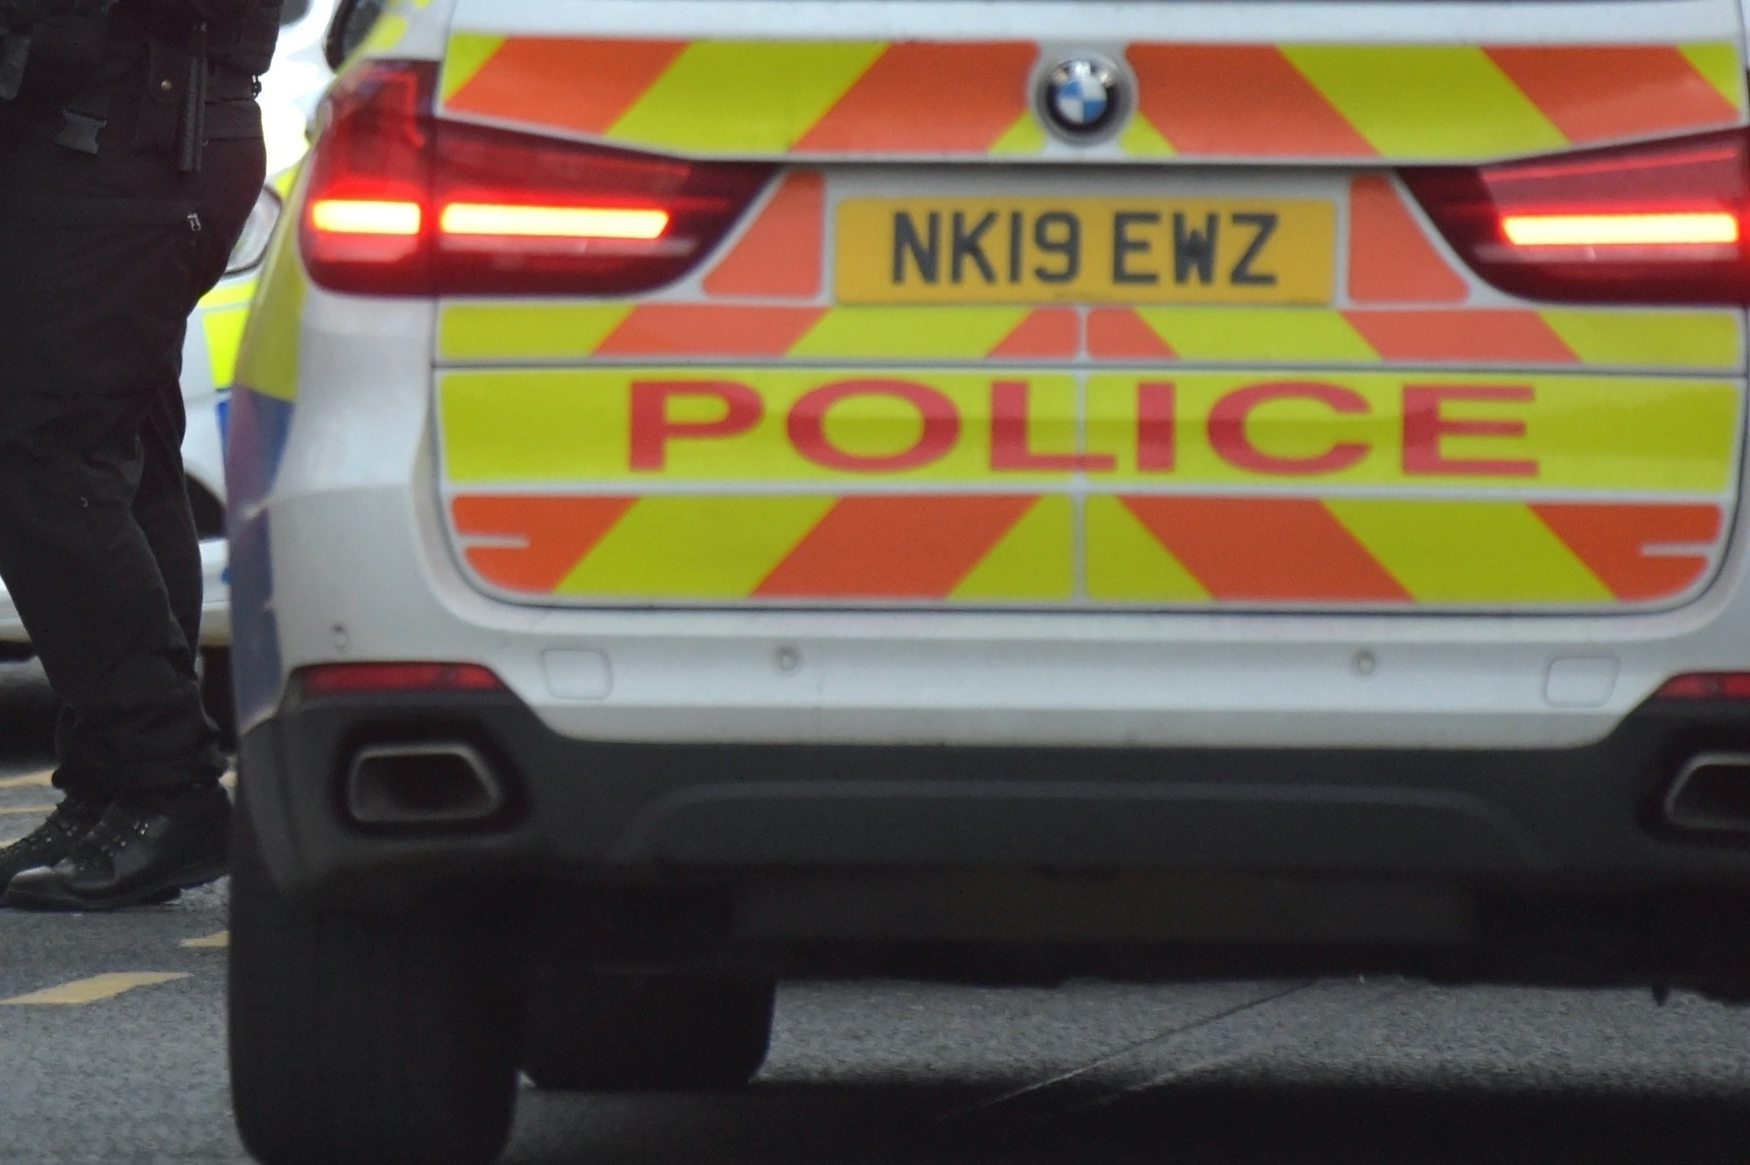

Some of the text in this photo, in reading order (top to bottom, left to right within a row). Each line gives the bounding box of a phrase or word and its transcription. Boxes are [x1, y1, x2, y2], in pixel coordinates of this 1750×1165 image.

[891, 210, 1280, 287] NK19 EWZ
[627, 377, 1540, 478] POLICE
